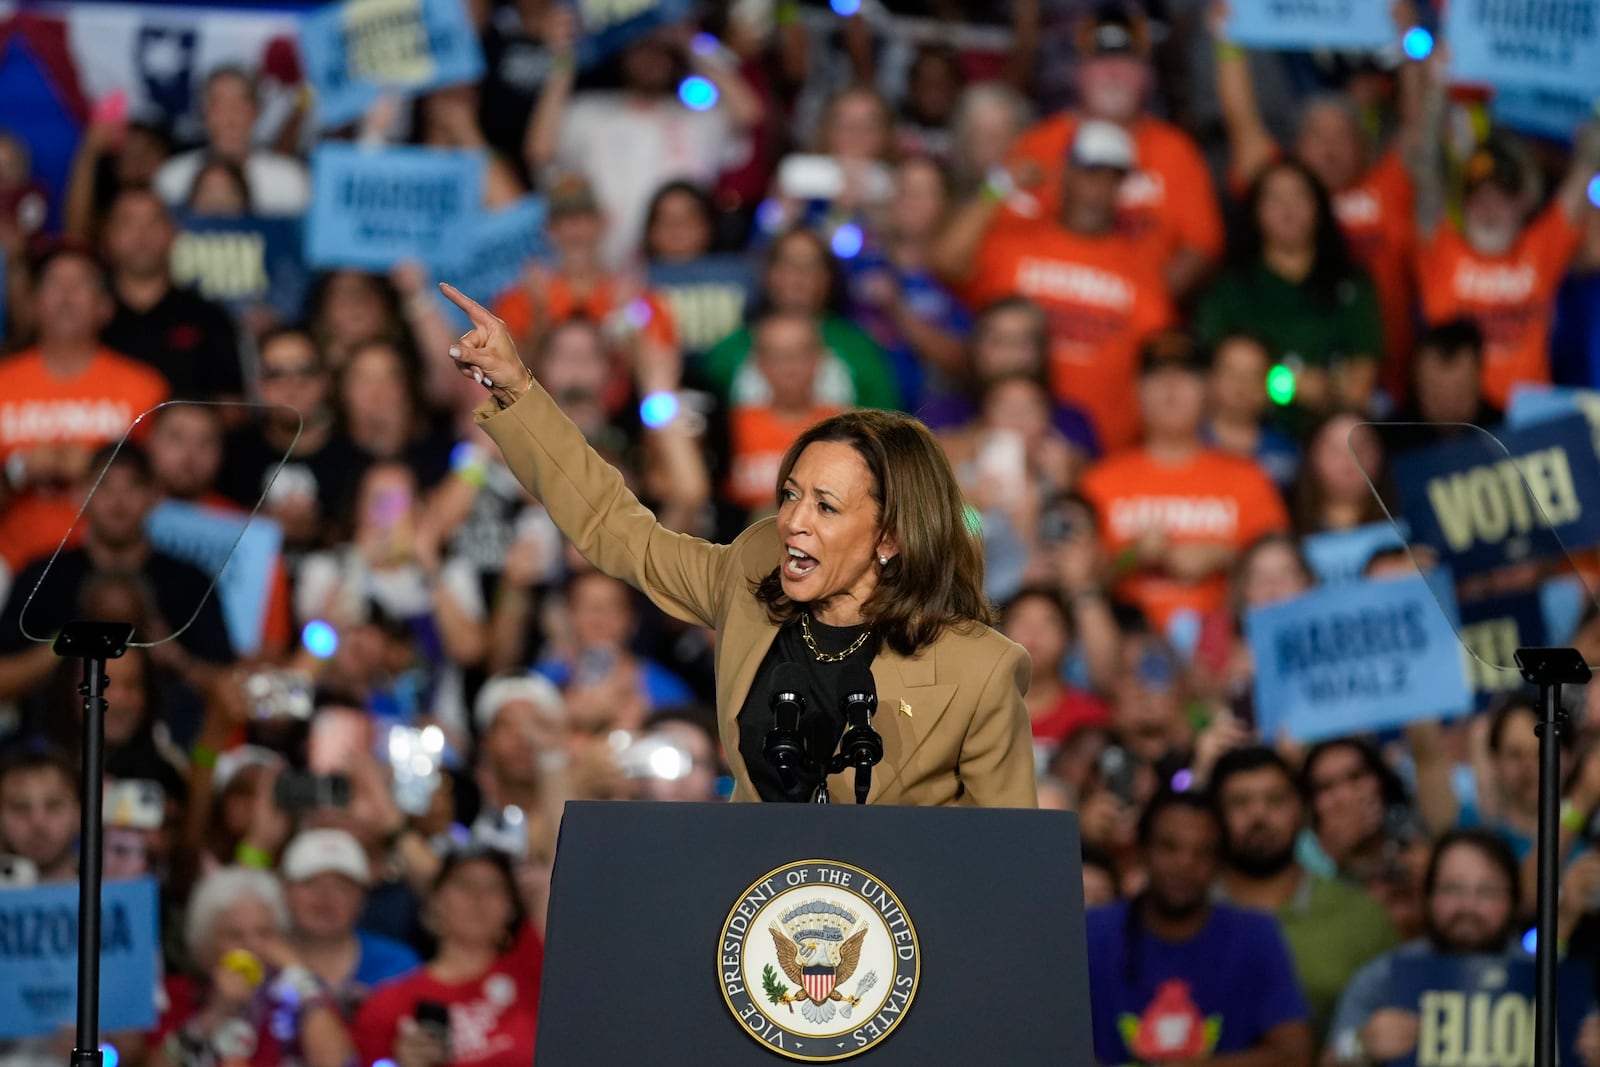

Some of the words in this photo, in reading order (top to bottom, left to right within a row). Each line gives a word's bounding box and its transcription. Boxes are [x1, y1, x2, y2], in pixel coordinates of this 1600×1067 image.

[1428, 446, 1581, 551] VOTE!
[1275, 600, 1428, 679] HARRIS
[1306, 663, 1406, 704] WALZ
[786, 869, 809, 886] OF
[817, 868, 852, 887] THE
[723, 878, 774, 996] PRESIDENT
[860, 879, 915, 961] UNITED
[739, 1002, 785, 1048] VICE
[853, 975, 913, 1047] STATES
